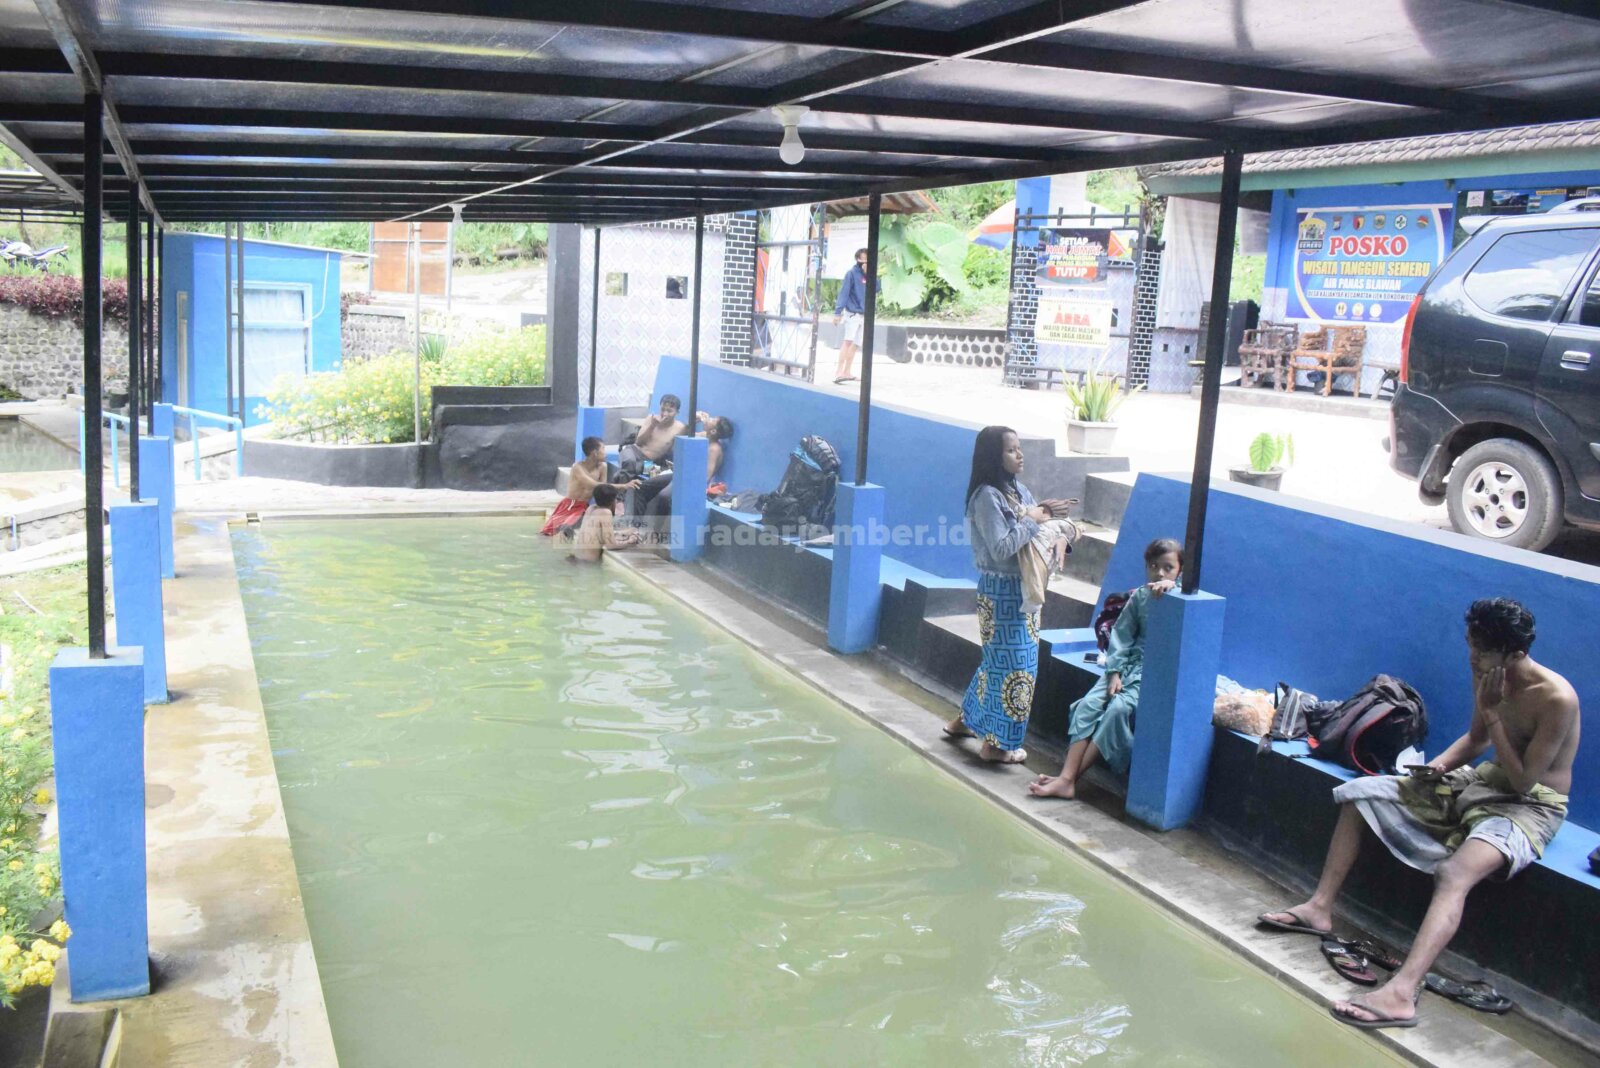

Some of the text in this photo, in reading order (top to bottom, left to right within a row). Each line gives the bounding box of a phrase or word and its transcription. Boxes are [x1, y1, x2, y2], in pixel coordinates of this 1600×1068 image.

[1060, 236, 1088, 246] SETIAP
[1328, 235, 1408, 255] POSKO
[1055, 267, 1087, 278] TUTUP
[1303, 260, 1430, 277] WISATA TANGGUH SEMERU
[1322, 278, 1401, 290] AIR PANAS BLAWAN
